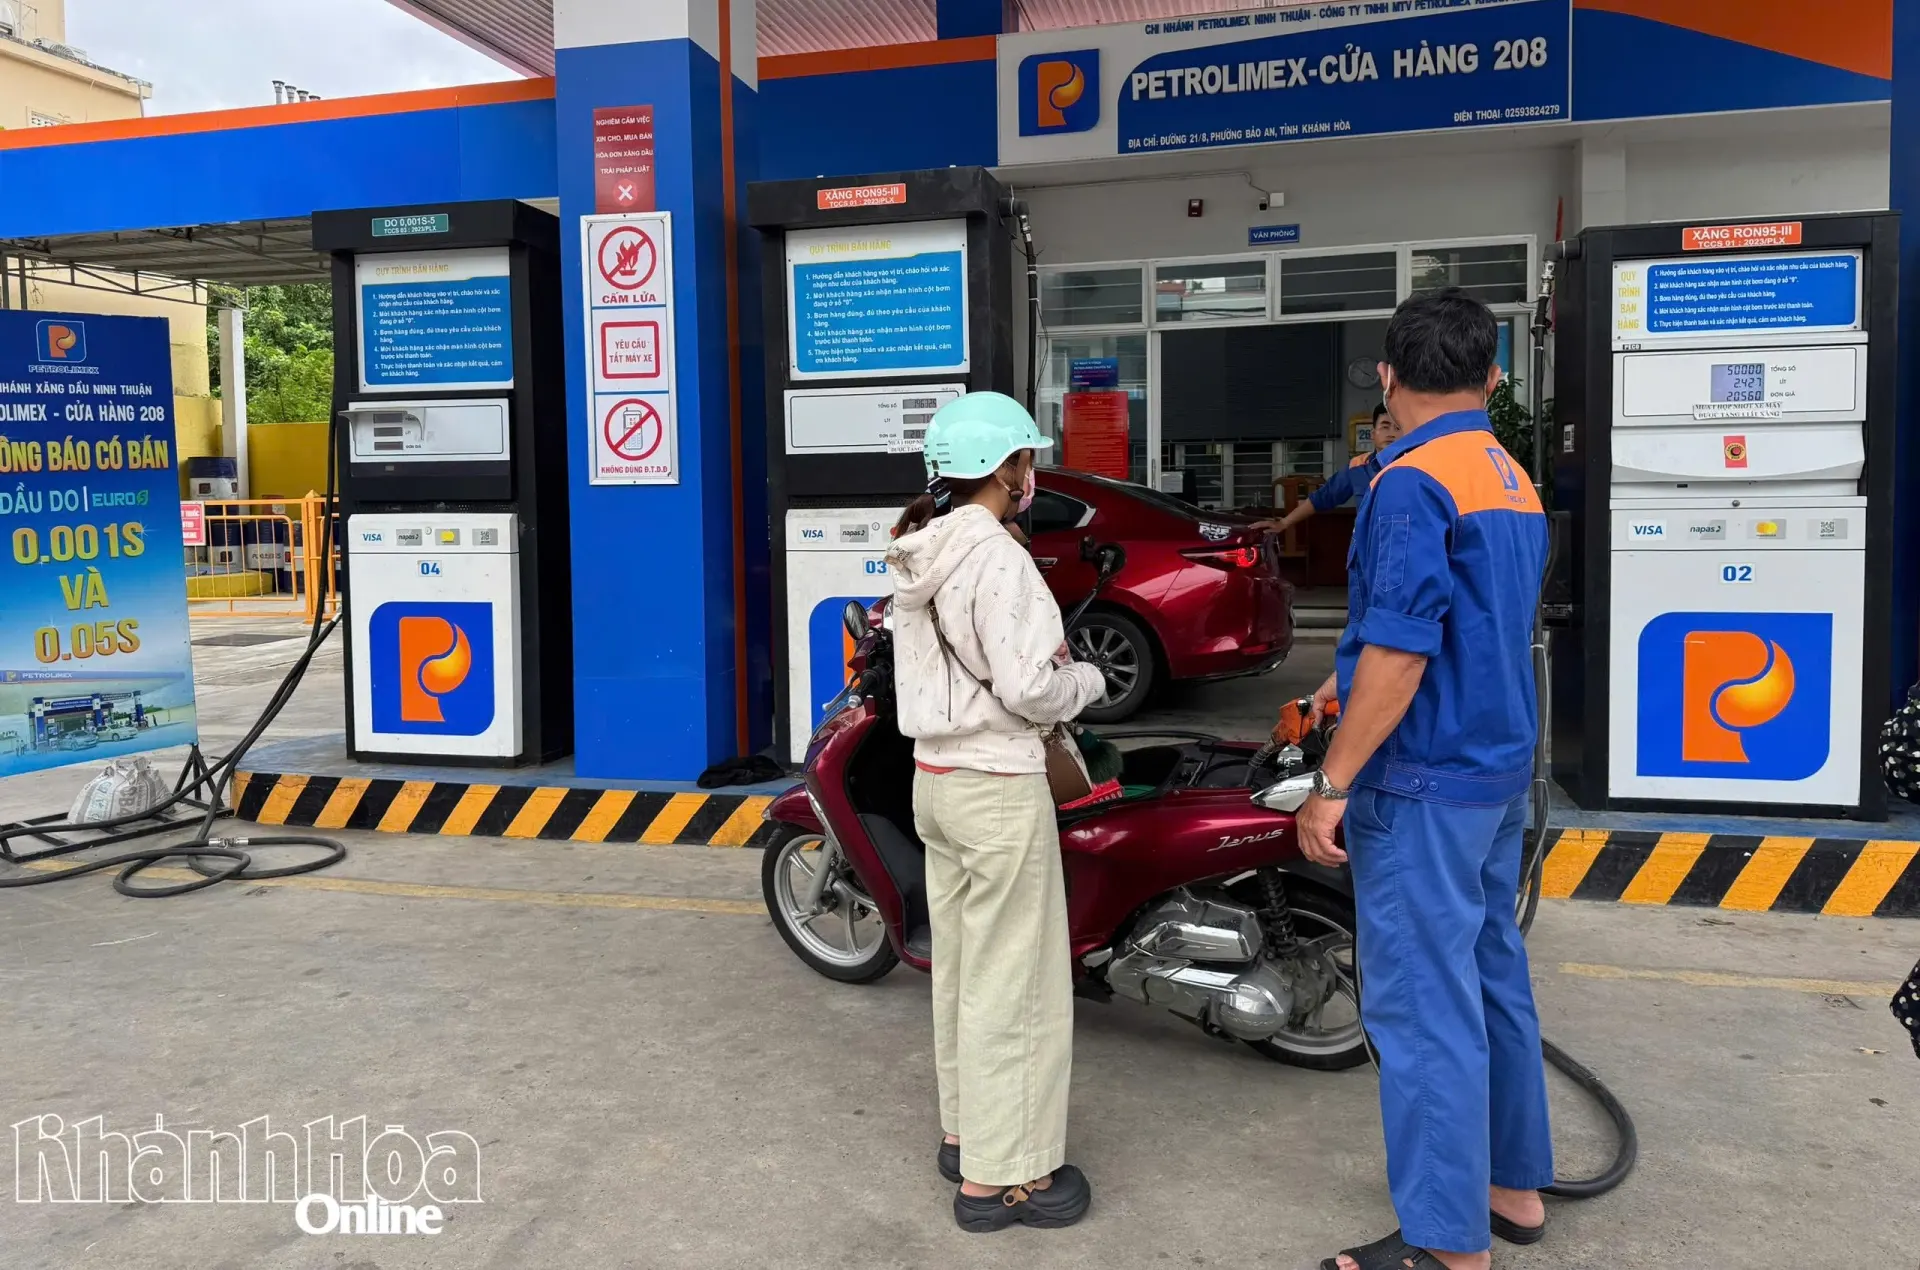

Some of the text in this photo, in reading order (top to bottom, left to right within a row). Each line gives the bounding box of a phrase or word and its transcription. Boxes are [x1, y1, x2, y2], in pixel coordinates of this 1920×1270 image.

[1145, 24, 1160, 35] CHI
[1163, 19, 1194, 33] NHÁNH
[1198, 15, 1250, 30] PETROLIMEX
[1254, 13, 1276, 25] NINH
[1280, 8, 1311, 23] THUẬN
[1319, 5, 1345, 19] CÔNG
[1348, 5, 1361, 16] TY
[1364, 3, 1388, 15] TNHH
[1392, 0, 1412, 12] MTV
[1393, 39, 1479, 79] HÀNG
[1493, 36, 1548, 71] 208
[1453, 110, 1473, 122] ĐIỆN
[1504, 104, 1560, 118] 02593824279
[595, 116, 651, 126] NGHIÊM CẤM VIỆC
[639, 132, 653, 140] BÁN
[1128, 138, 1141, 149] ĐỊA
[1160, 132, 1187, 146] ĐƯỜNG
[1210, 127, 1242, 141] PHƯỜNG
[1279, 122, 1298, 135] TỈNH
[1301, 121, 1331, 134] KHÁNH
[1333, 118, 1351, 131] HÒA
[634, 164, 650, 174] LUẬT
[825, 187, 899, 201] XĂNG RON95-III
[829, 200, 849, 208] TCCS
[863, 197, 895, 205] 2023/PLX
[384, 216, 436, 228] DO 0,001S-5
[1252, 229, 1296, 239] VĂN PHÒNG
[1692, 225, 1792, 240] XĂNG RON95-III
[809, 245, 824, 255] QUY
[827, 241, 850, 253] TRÌNH
[869, 239, 892, 250] HÀNG
[1698, 240, 1723, 248] TCCS
[1725, 239, 1735, 247] 01
[1743, 237, 1785, 246] 2023/PLX
[375, 266, 389, 277] QUY
[1620, 272, 1636, 282] QUY
[1617, 285, 1640, 297] TRÌNH
[602, 291, 656, 304] CẤM LỬA
[1620, 302, 1637, 313] BÁN
[1617, 317, 1640, 329] HÀNG
[614, 337, 646, 349] YÊU CẦU
[609, 351, 653, 363] TẮT MÁY XE
[28, 365, 99, 374] PETROLIMEX
[1727, 364, 1762, 376] 50000
[36, 381, 65, 394] XĂNG
[68, 380, 90, 394] DẦU
[93, 384, 117, 395] NINH
[120, 383, 152, 397] THUẬN
[1733, 377, 1762, 388] 2.427
[1726, 390, 1762, 402] 20560
[65, 400, 94, 421] CỬA
[98, 401, 135, 421] HÀNG
[140, 406, 165, 421] 208
[47, 435, 91, 472] BÁO
[95, 435, 123, 471] CÓ
[127, 435, 169, 470] BÁN
[601, 465, 624, 474] KHÔNG
[624, 464, 643, 473] DÙNG
[0, 482, 43, 515] DẦU
[50, 489, 79, 512] DO
[802, 529, 824, 538] VISA
[1633, 525, 1663, 535] VISA
[12, 521, 145, 565] 0.001S
[362, 533, 382, 542] VISA
[420, 562, 441, 575] 04
[865, 560, 887, 574] 03
[1722, 565, 1752, 582] 02
[59, 566, 109, 610] VÀ
[34, 618, 141, 664] 0.05S
